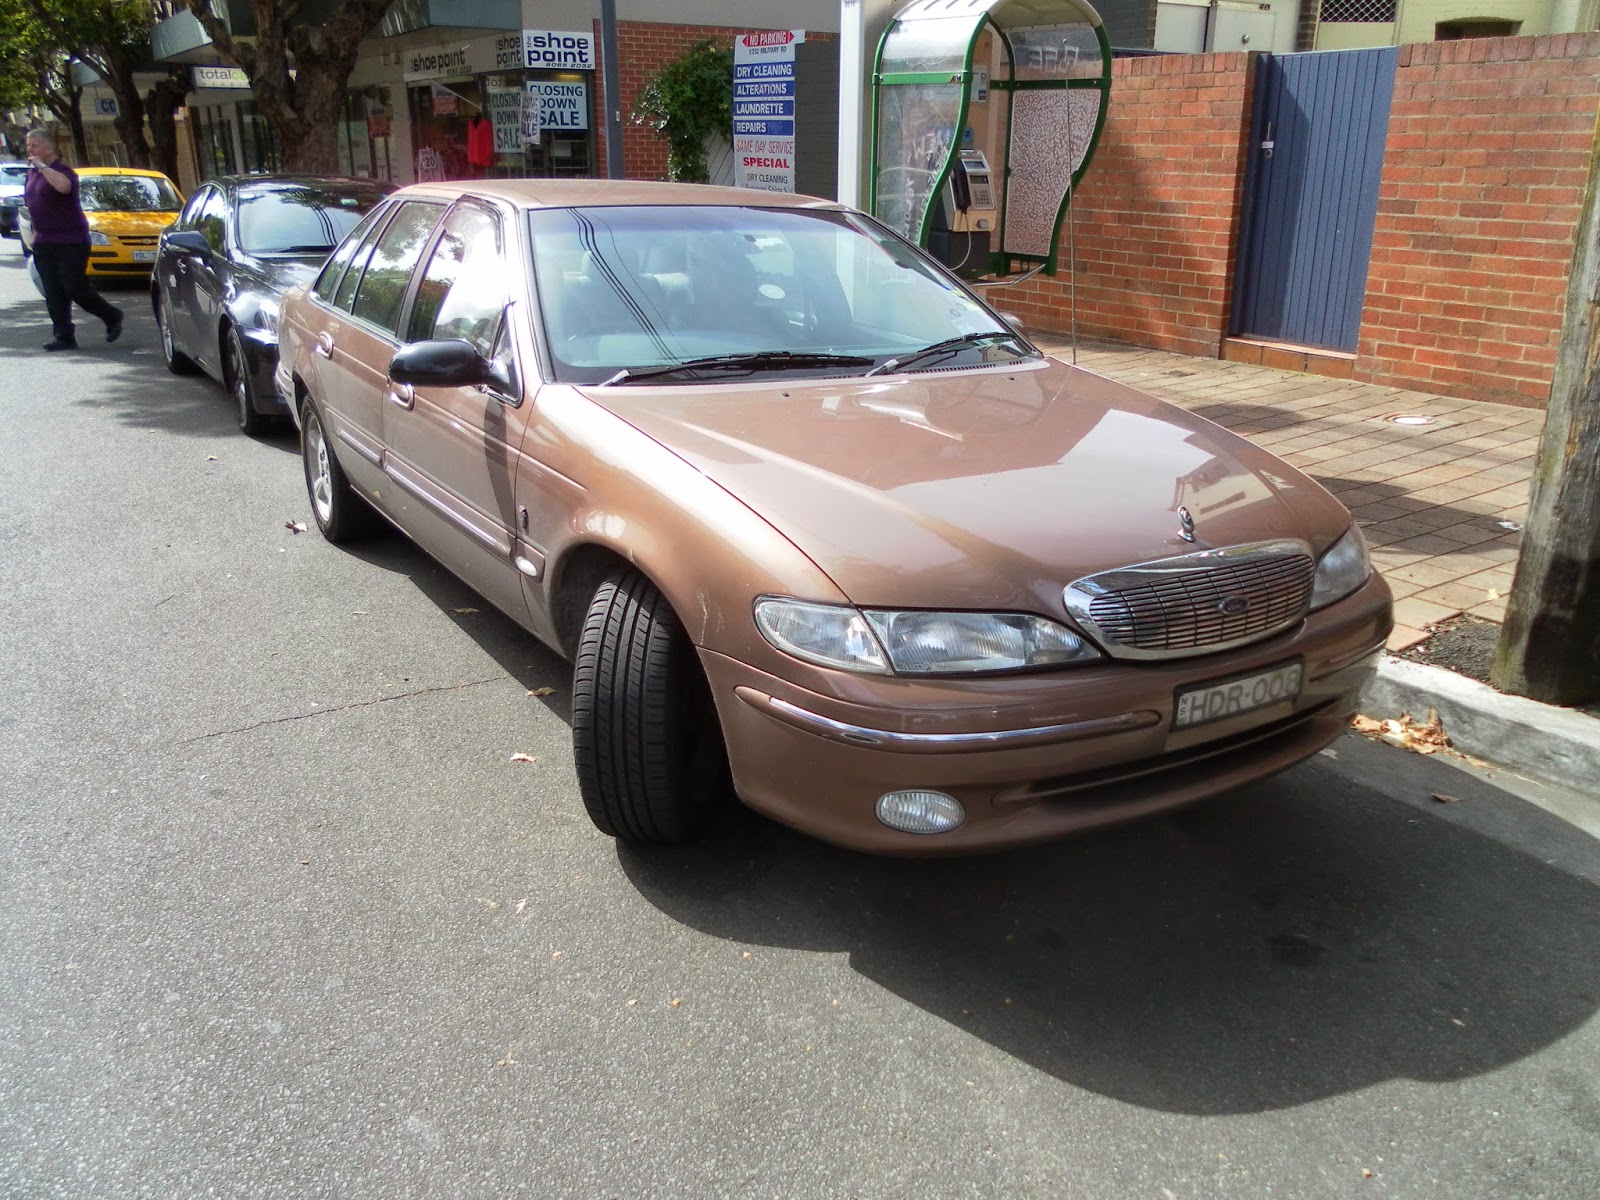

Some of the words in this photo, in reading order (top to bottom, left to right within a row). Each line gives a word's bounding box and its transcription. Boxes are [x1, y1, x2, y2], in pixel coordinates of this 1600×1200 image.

[498, 36, 520, 51] shoe
[533, 33, 589, 49] shoe
[750, 35, 759, 46] NO
[760, 31, 787, 45] PARKING
[760, 46, 779, 54] MILITARY
[413, 53, 437, 72] shoe
[438, 48, 466, 73] point
[496, 50, 522, 69] point
[527, 50, 589, 66] point
[737, 67, 751, 77] DRY
[753, 64, 792, 77] CLEANING
[530, 85, 582, 97] CLOSING
[737, 84, 787, 95] ALTERATIONS
[492, 93, 520, 109] CLOSING
[736, 103, 783, 114] LAUNDRETTE
[496, 110, 518, 126] DOWN
[540, 110, 580, 126] SALE
[736, 122, 766, 133] REPAIRS
[496, 128, 522, 149] SALE
[736, 140, 753, 153] SAME
[755, 141, 766, 153] DAY
[769, 141, 793, 155] SERVICE
[743, 156, 790, 169] SPECIAL
[747, 173, 758, 182] DRY
[758, 173, 788, 185] CLEANING
